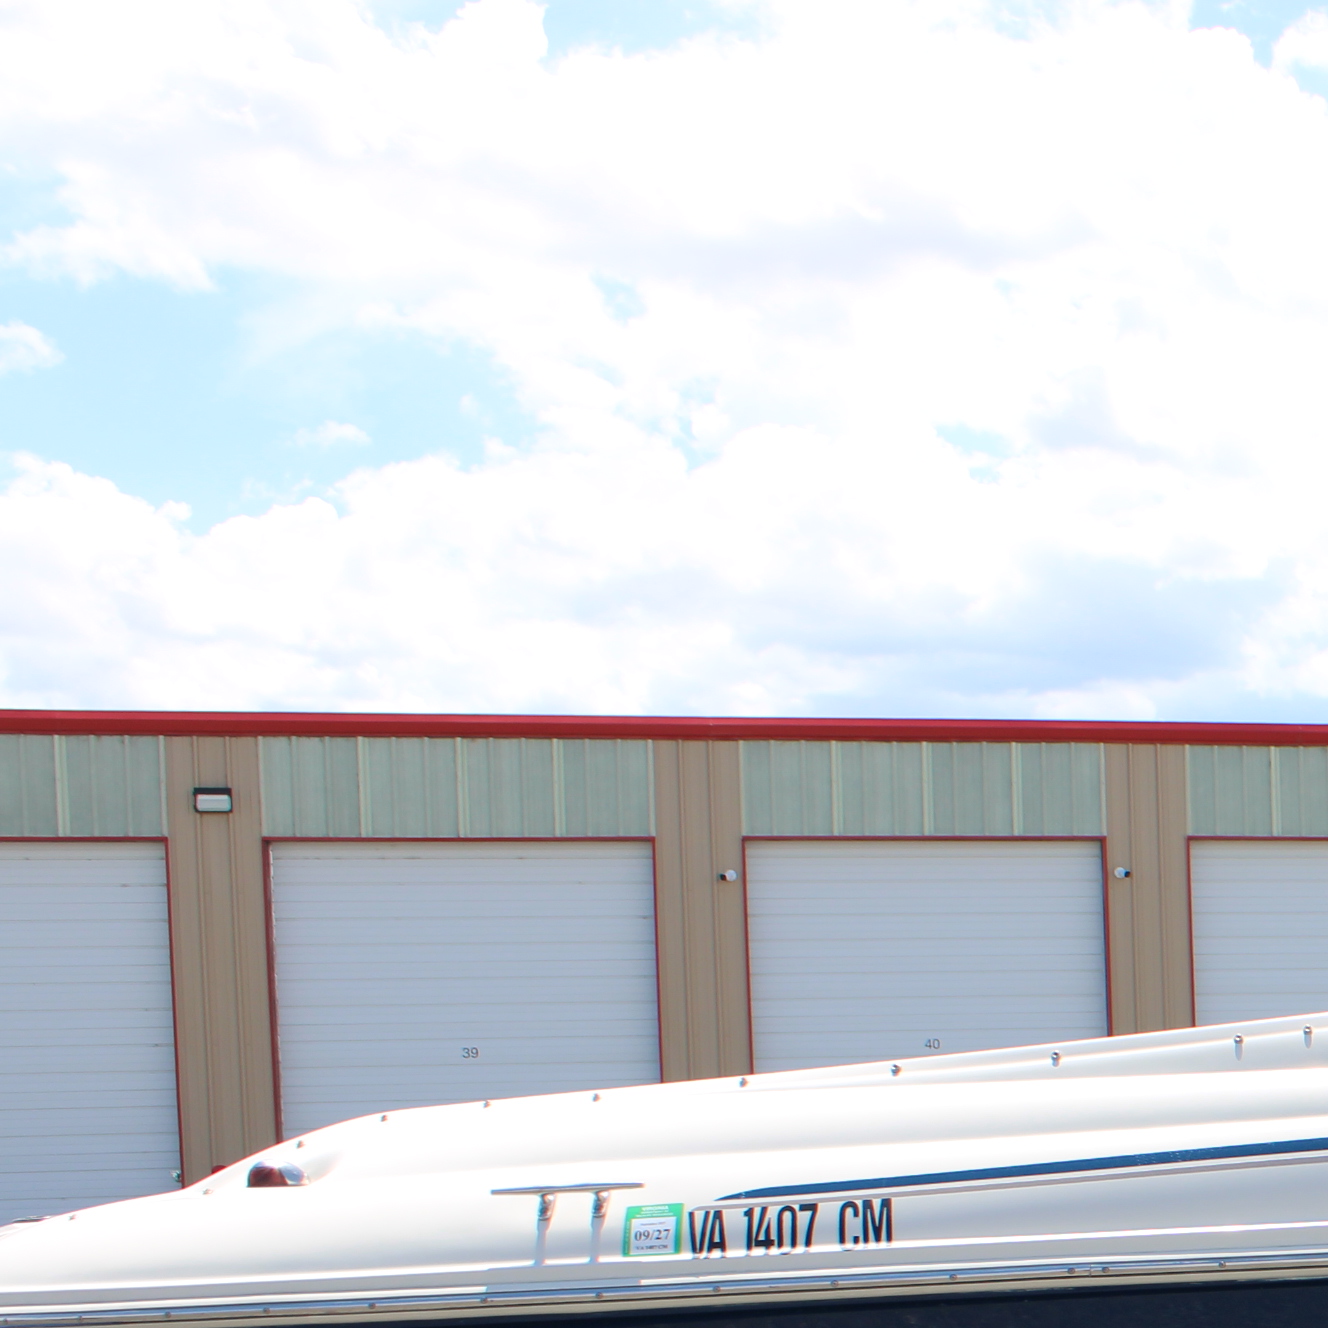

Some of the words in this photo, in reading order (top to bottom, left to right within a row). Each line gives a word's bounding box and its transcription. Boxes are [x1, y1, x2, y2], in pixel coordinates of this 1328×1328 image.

[924, 1038, 941, 1050] 40
[462, 1047, 479, 1059] 39
[634, 1228, 671, 1241] 09/27
[688, 1209, 727, 1259] VA
[743, 1203, 819, 1257] 1407
[839, 1198, 893, 1252] CM
